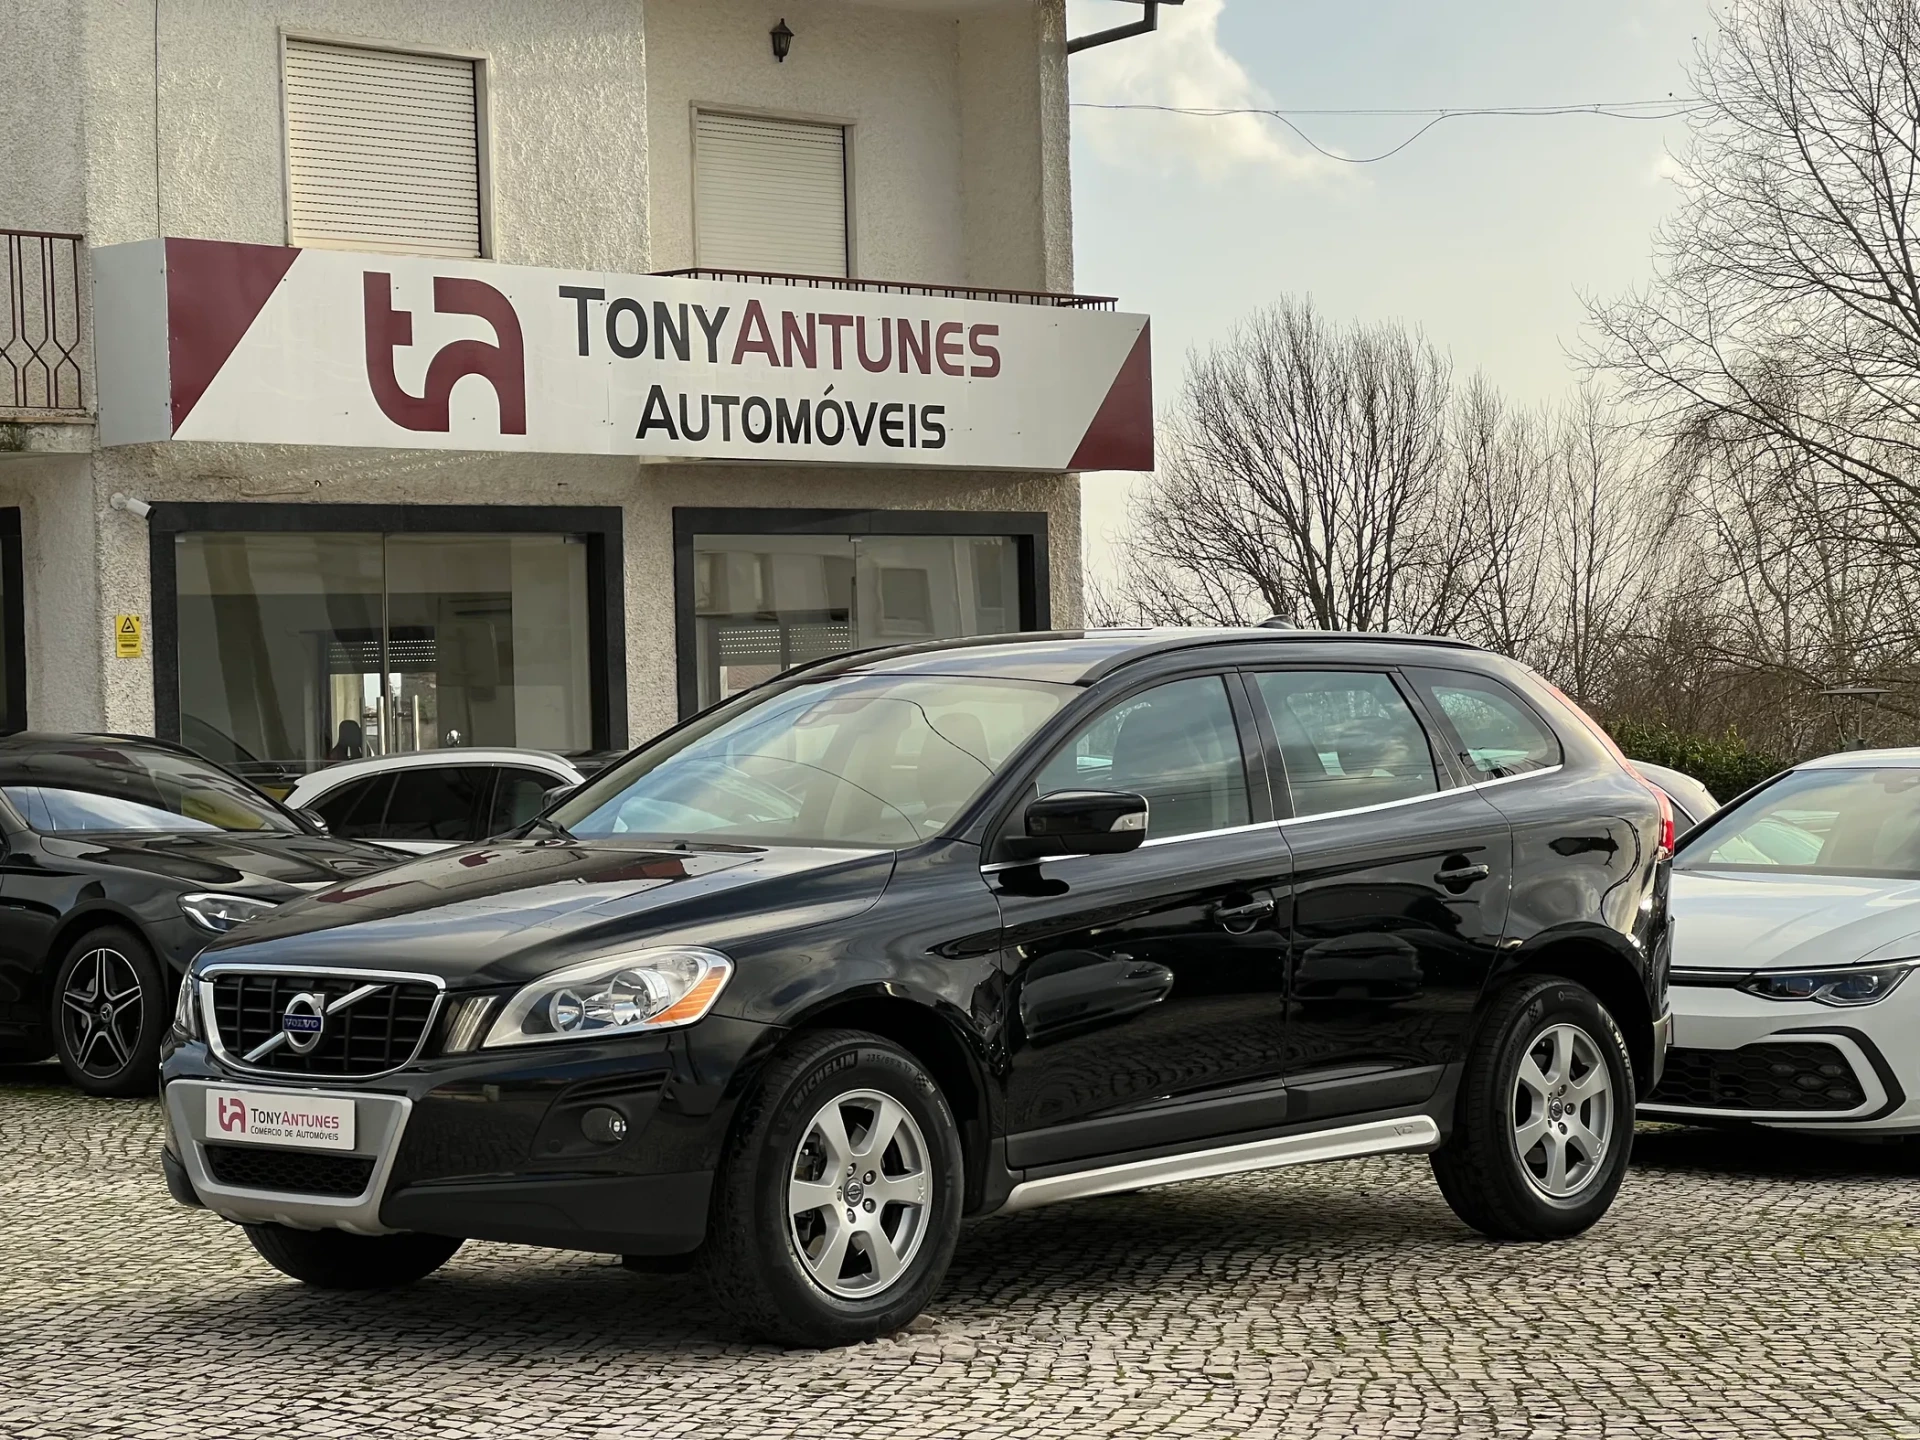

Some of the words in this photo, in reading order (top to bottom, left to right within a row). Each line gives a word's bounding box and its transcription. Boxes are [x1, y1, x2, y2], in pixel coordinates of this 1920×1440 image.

[635, 383, 946, 449] AUTOMÓVEIS
[284, 1018, 319, 1028] VOLVO
[792, 1053, 856, 1109] MICHELIN
[284, 1129, 293, 1138] DE
[296, 1129, 339, 1141] AUTOMÓVEIS
